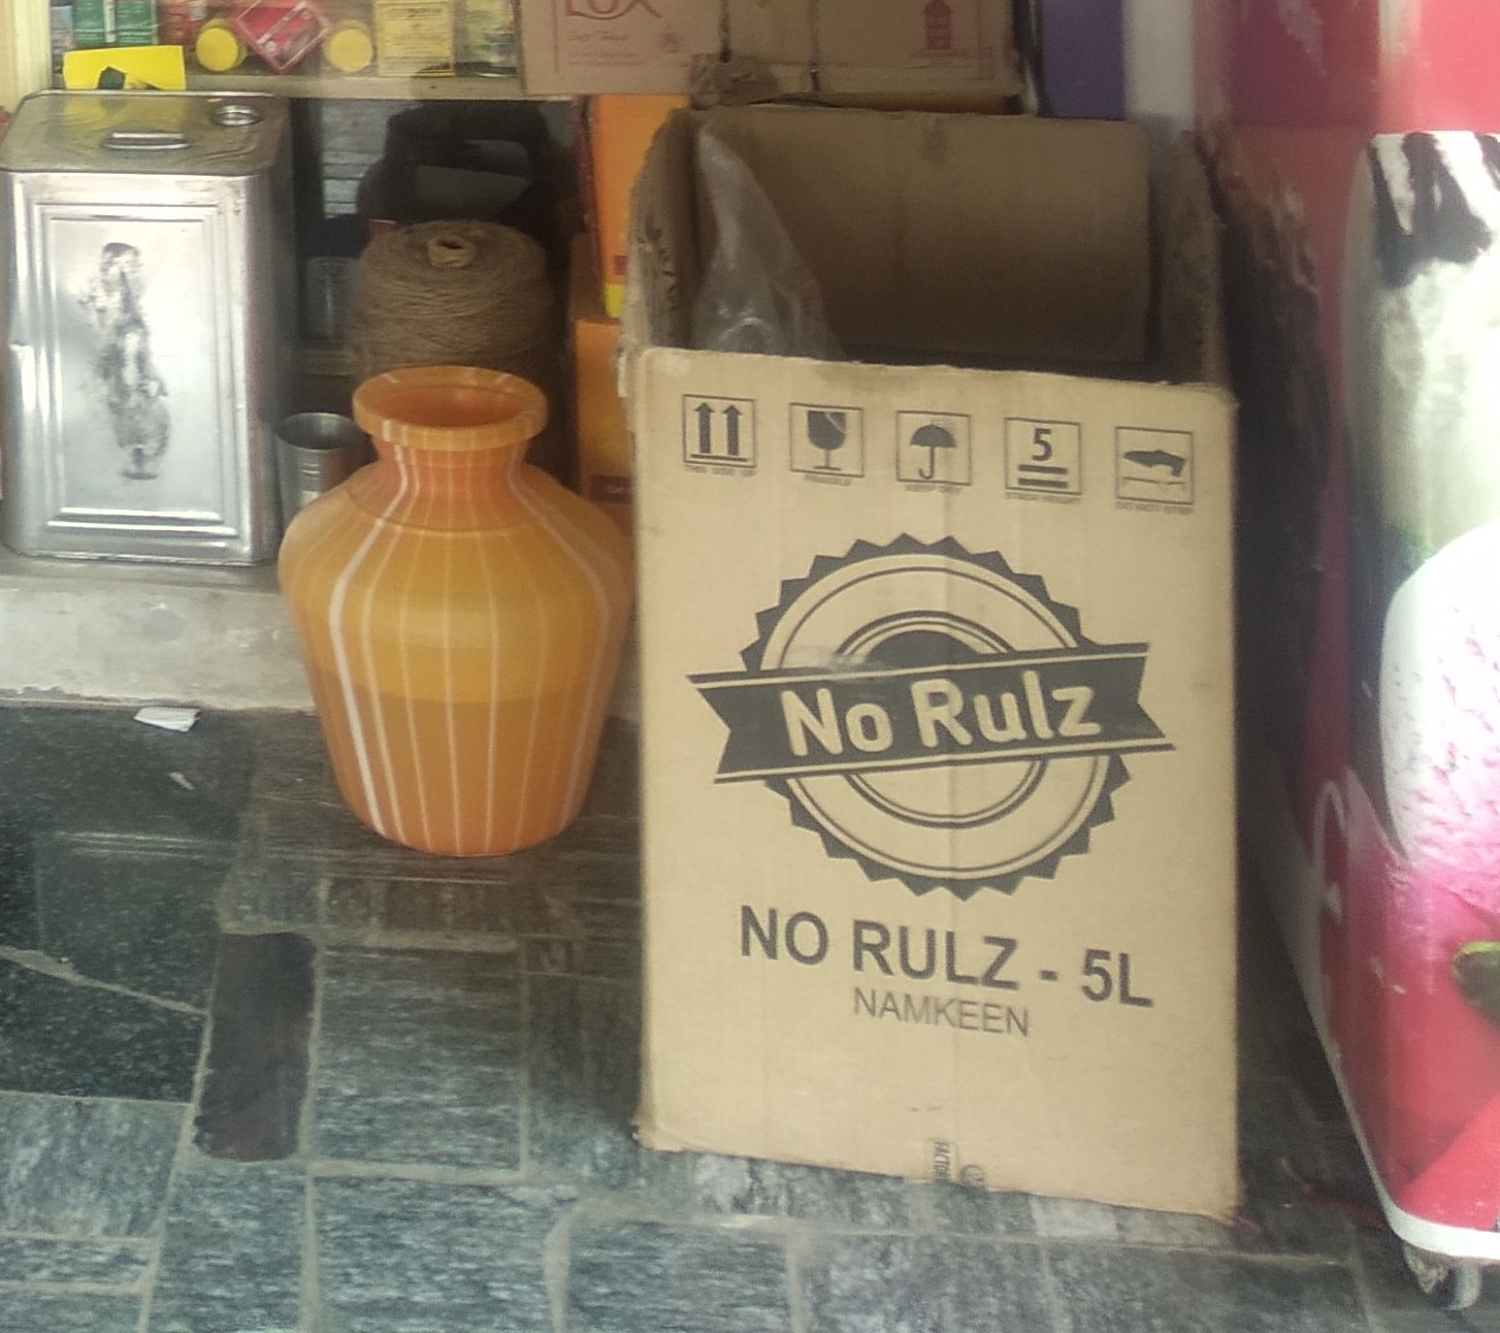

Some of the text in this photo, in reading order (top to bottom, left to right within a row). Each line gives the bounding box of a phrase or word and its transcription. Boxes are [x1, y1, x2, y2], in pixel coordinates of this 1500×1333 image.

[1032, 428, 1052, 462] 5
[781, 670, 1101, 757] No Rulz
[740, 904, 829, 966] NO
[852, 919, 1020, 992] RULZ
[1080, 948, 1155, 1009] 5L
[852, 987, 1030, 1038] NAMKEEN
